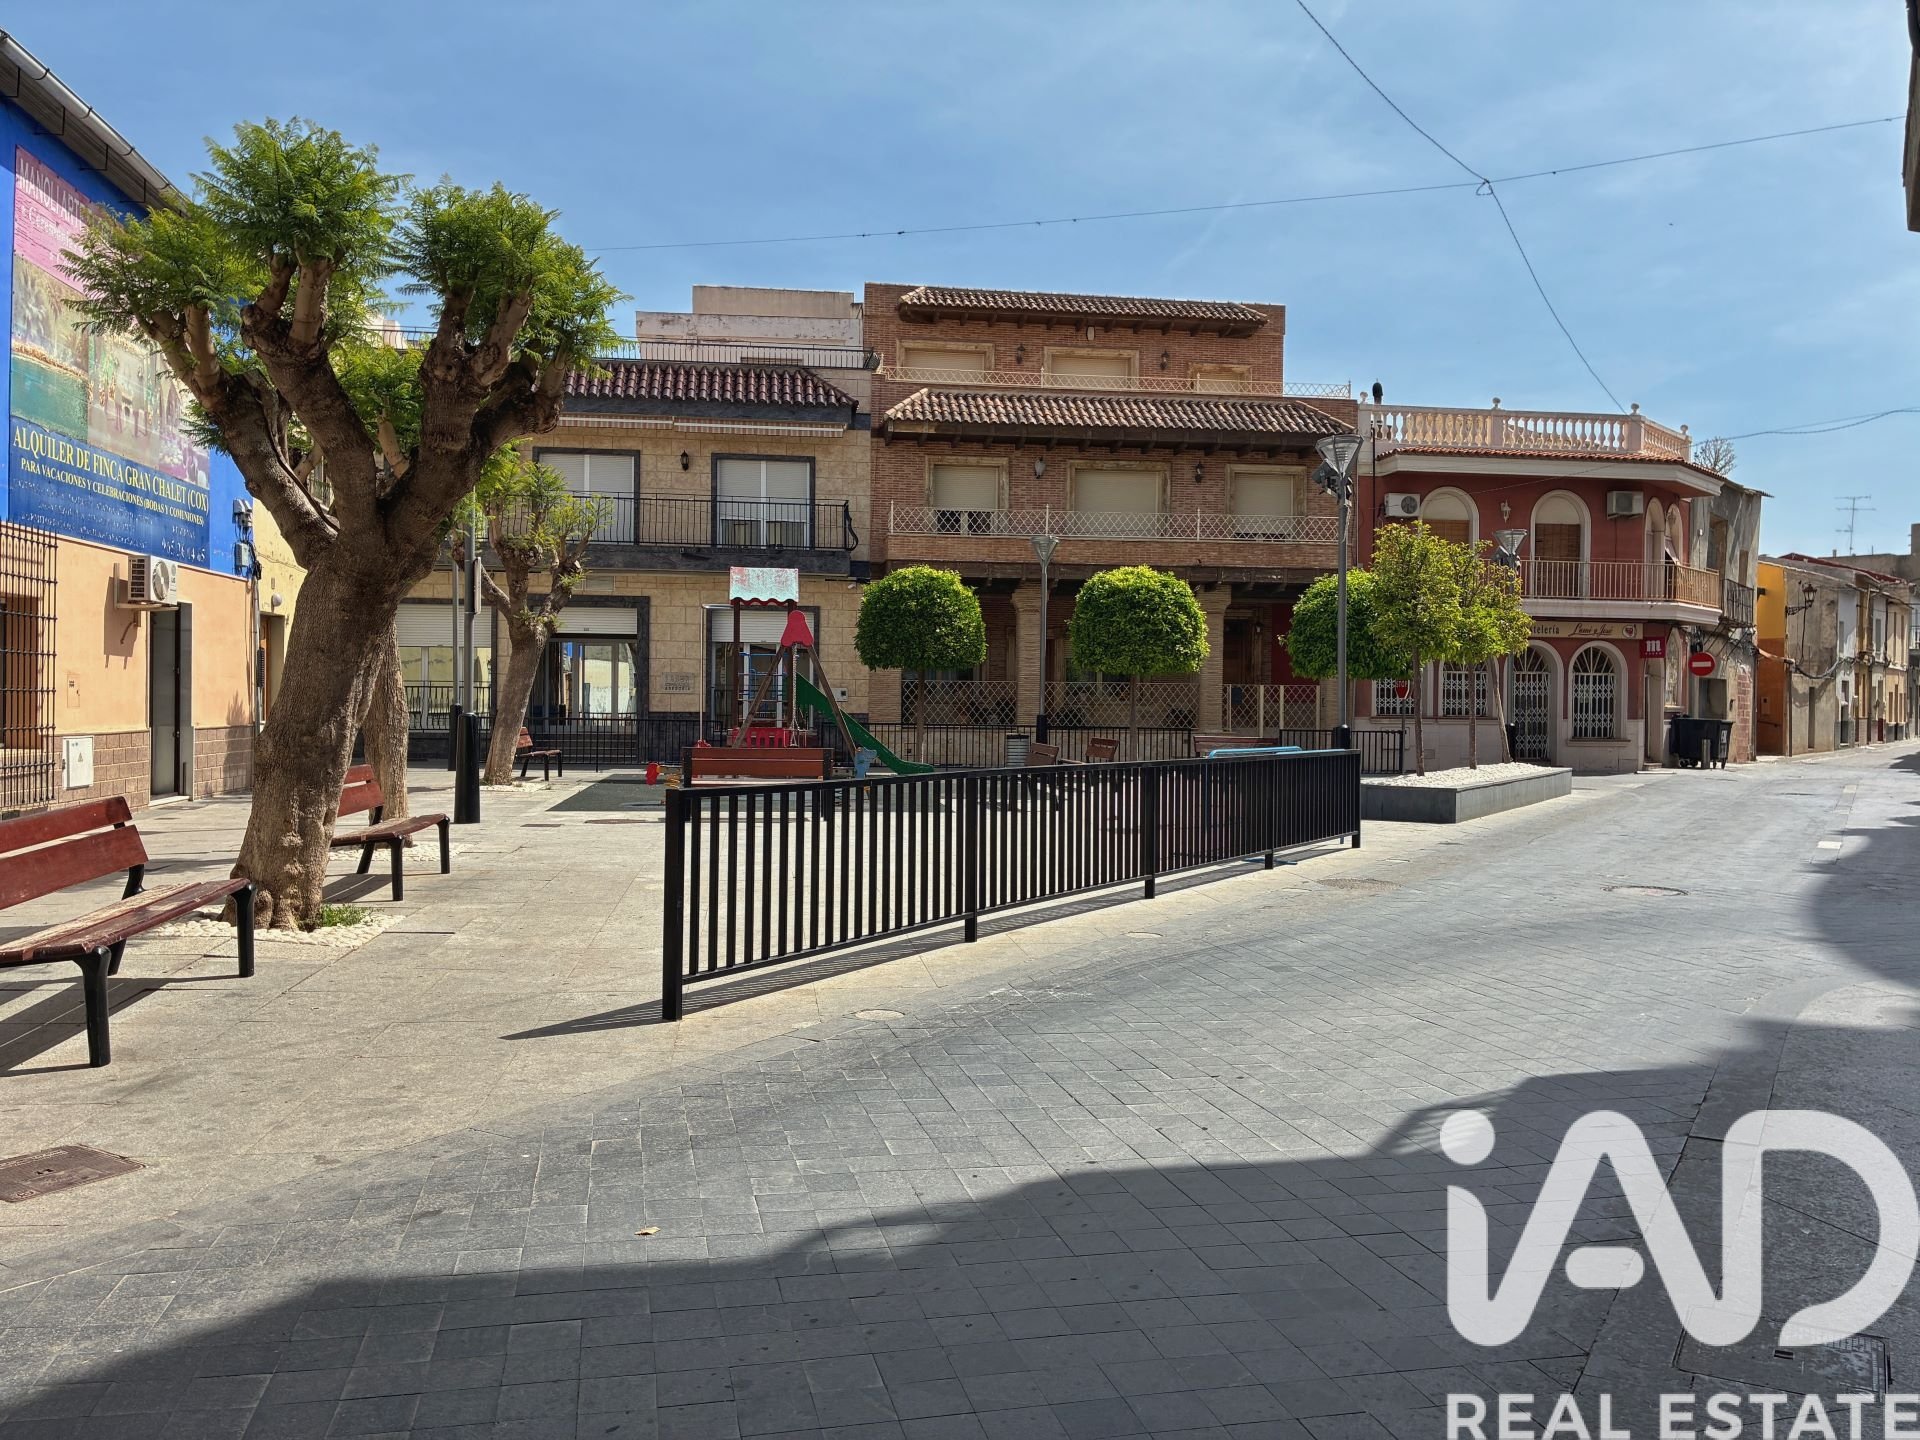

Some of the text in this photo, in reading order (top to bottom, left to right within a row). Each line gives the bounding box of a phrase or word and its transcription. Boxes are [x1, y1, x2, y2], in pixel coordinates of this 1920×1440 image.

[20, 158, 60, 214] MANOLI
[13, 425, 74, 466] ALQUILER
[76, 447, 91, 472] DE
[93, 453, 124, 483] FINCA
[125, 465, 151, 492] GRAN
[152, 476, 187, 505] CHALET
[187, 488, 209, 516] (COX)
[21, 457, 41, 475] PARA
[41, 463, 87, 489] VACACIONES
[92, 481, 144, 508] CELEBRACIONES
[144, 494, 165, 513] (BODAS
